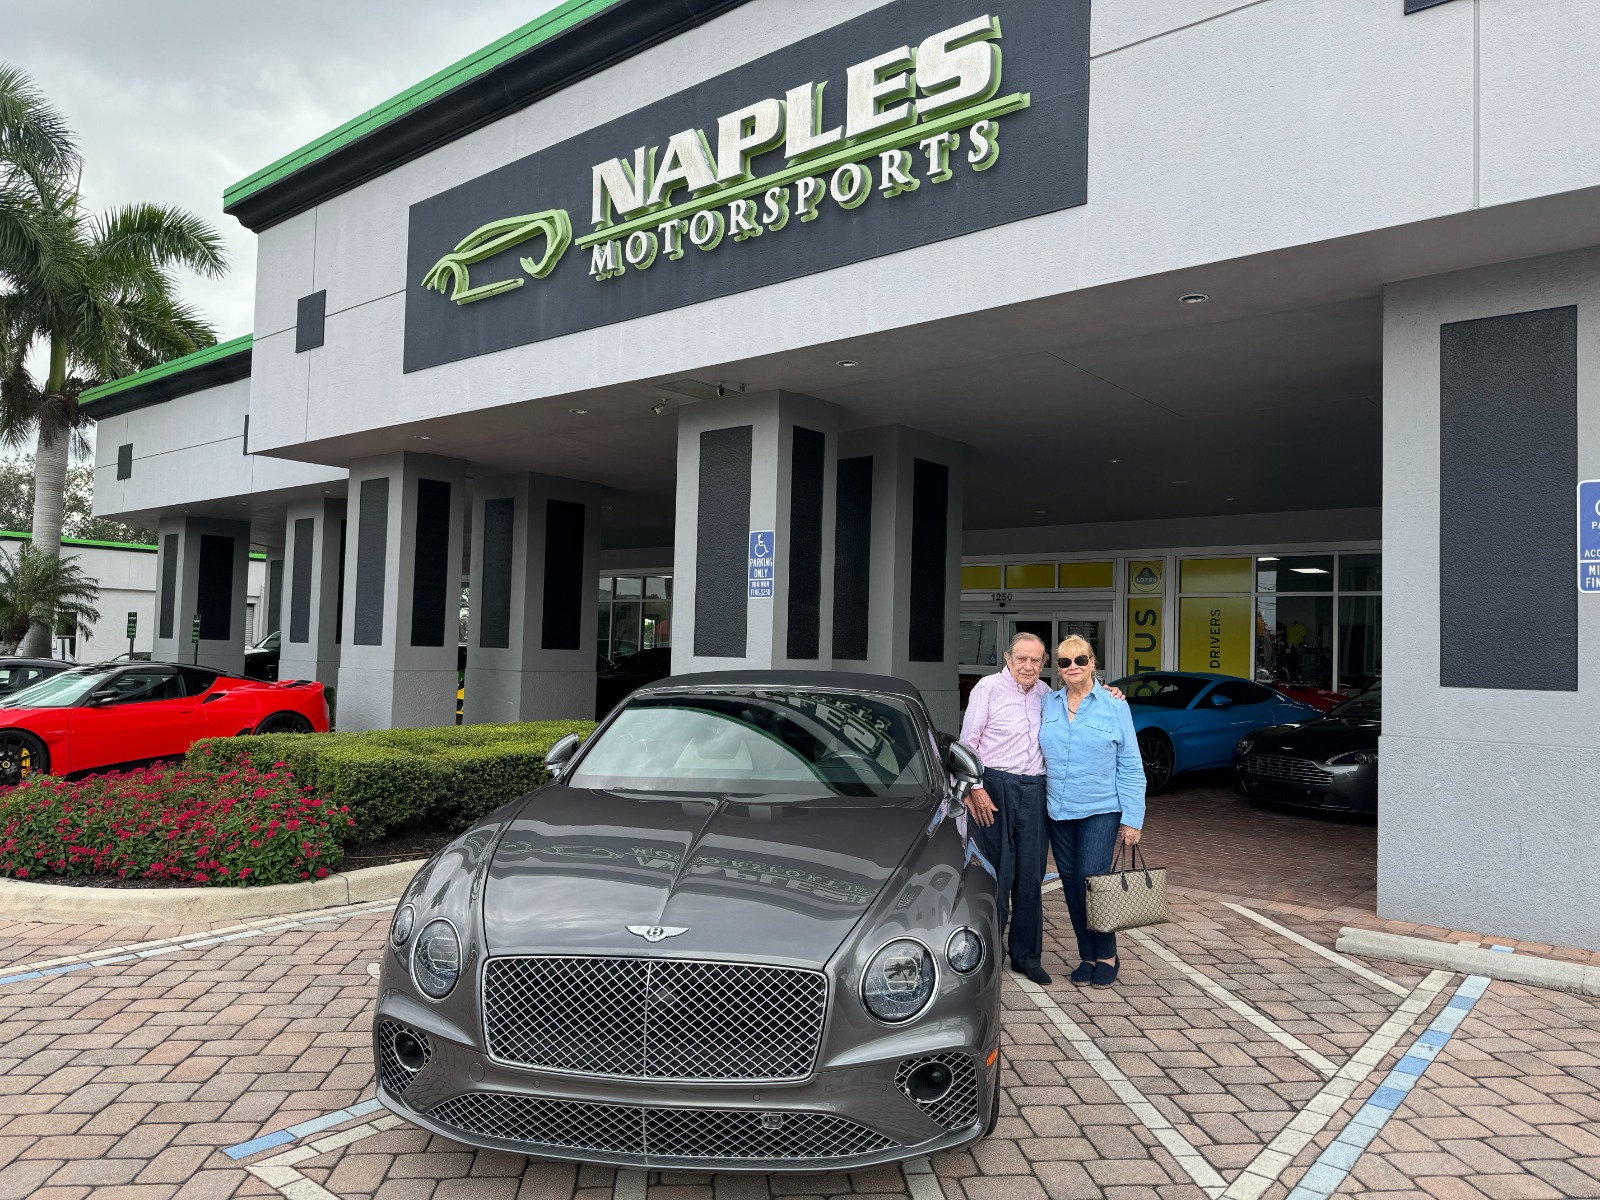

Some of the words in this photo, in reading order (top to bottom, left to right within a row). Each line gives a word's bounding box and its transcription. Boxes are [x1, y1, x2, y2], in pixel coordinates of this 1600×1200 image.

[590, 14, 1003, 228] NAPLES
[588, 120, 1000, 281] MOTORSPORTS
[750, 557, 773, 568] PARKING
[753, 569, 769, 578] ONLY
[991, 593, 1013, 601] 1250
[1209, 608, 1221, 669] DRIVERS
